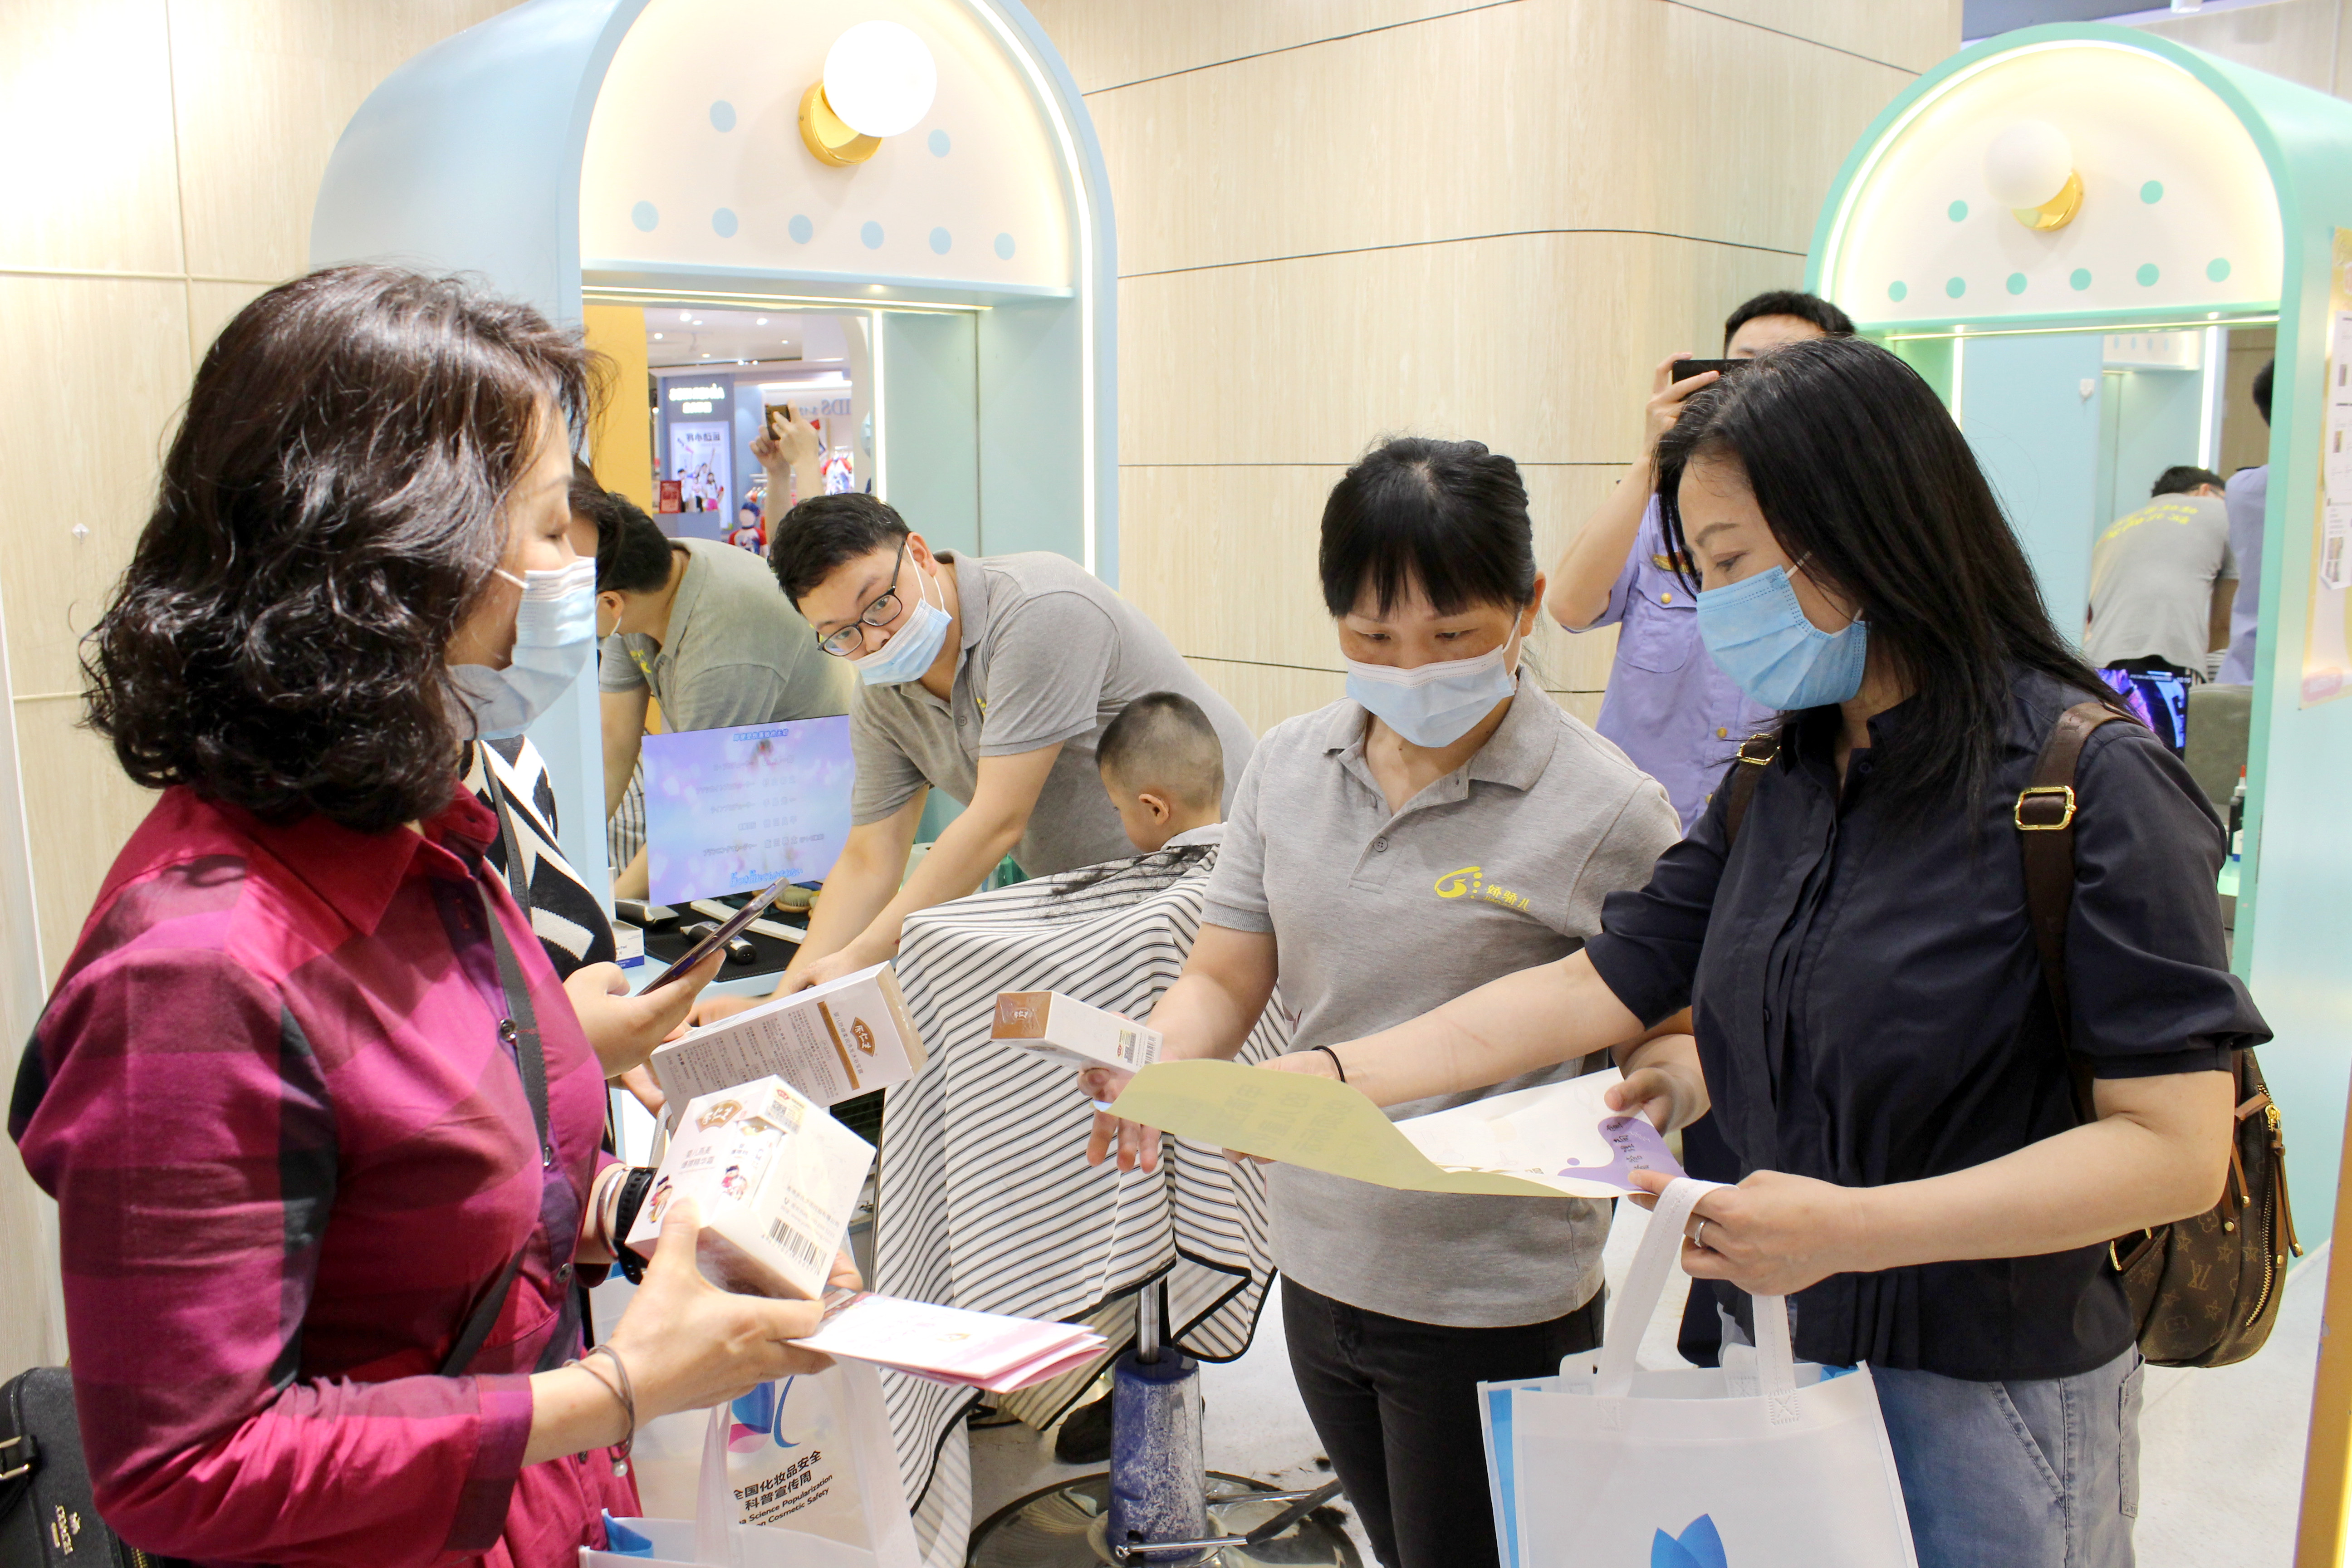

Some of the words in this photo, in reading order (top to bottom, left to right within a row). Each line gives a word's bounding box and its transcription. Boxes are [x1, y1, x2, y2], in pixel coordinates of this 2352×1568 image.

[734, 1450, 822, 1500] 全国化妆品安全
[745, 1470, 811, 1511] 科普宣传周
[749, 1505, 780, 1522] Science
[782, 1475, 833, 1507] Popularization
[769, 1502, 805, 1523] Cosmetic
[807, 1488, 829, 1504] Safety
